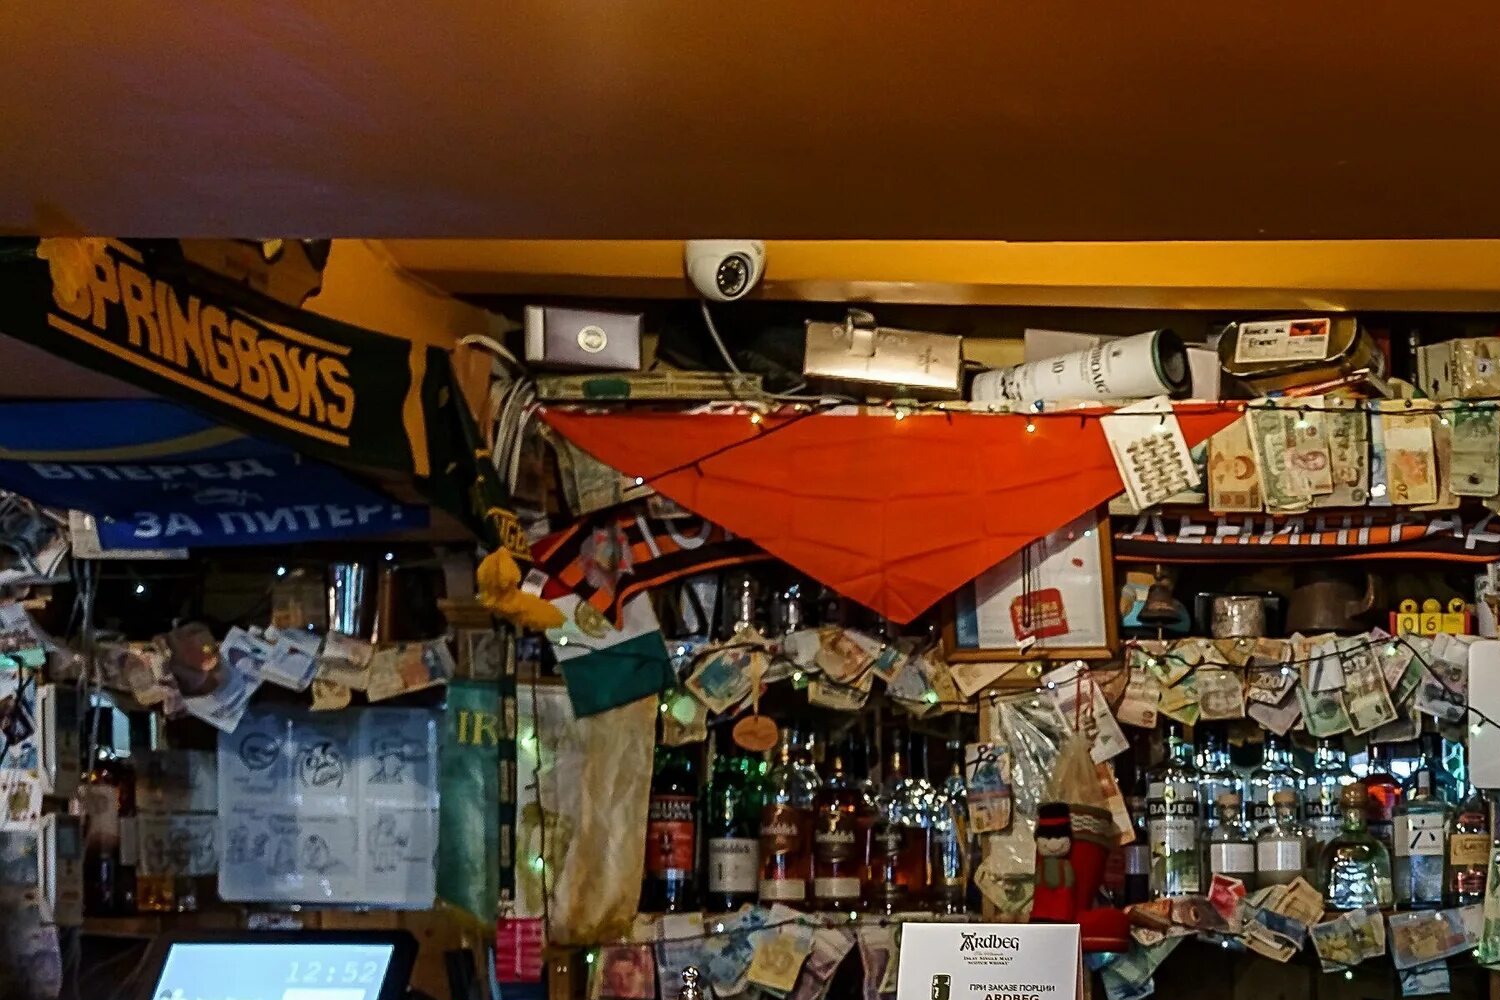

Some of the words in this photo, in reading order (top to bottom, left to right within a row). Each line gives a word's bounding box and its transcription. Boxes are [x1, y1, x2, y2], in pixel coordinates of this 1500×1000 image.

[133, 511, 203, 538] ЗА
[1149, 803, 1195, 815] BAUER
[285, 961, 378, 983] 12:52
[969, 983, 987, 992] ПРИ
[988, 983, 1018, 992] ЗАКАЗЕ
[1019, 983, 1056, 993] ПОРЦИИ
